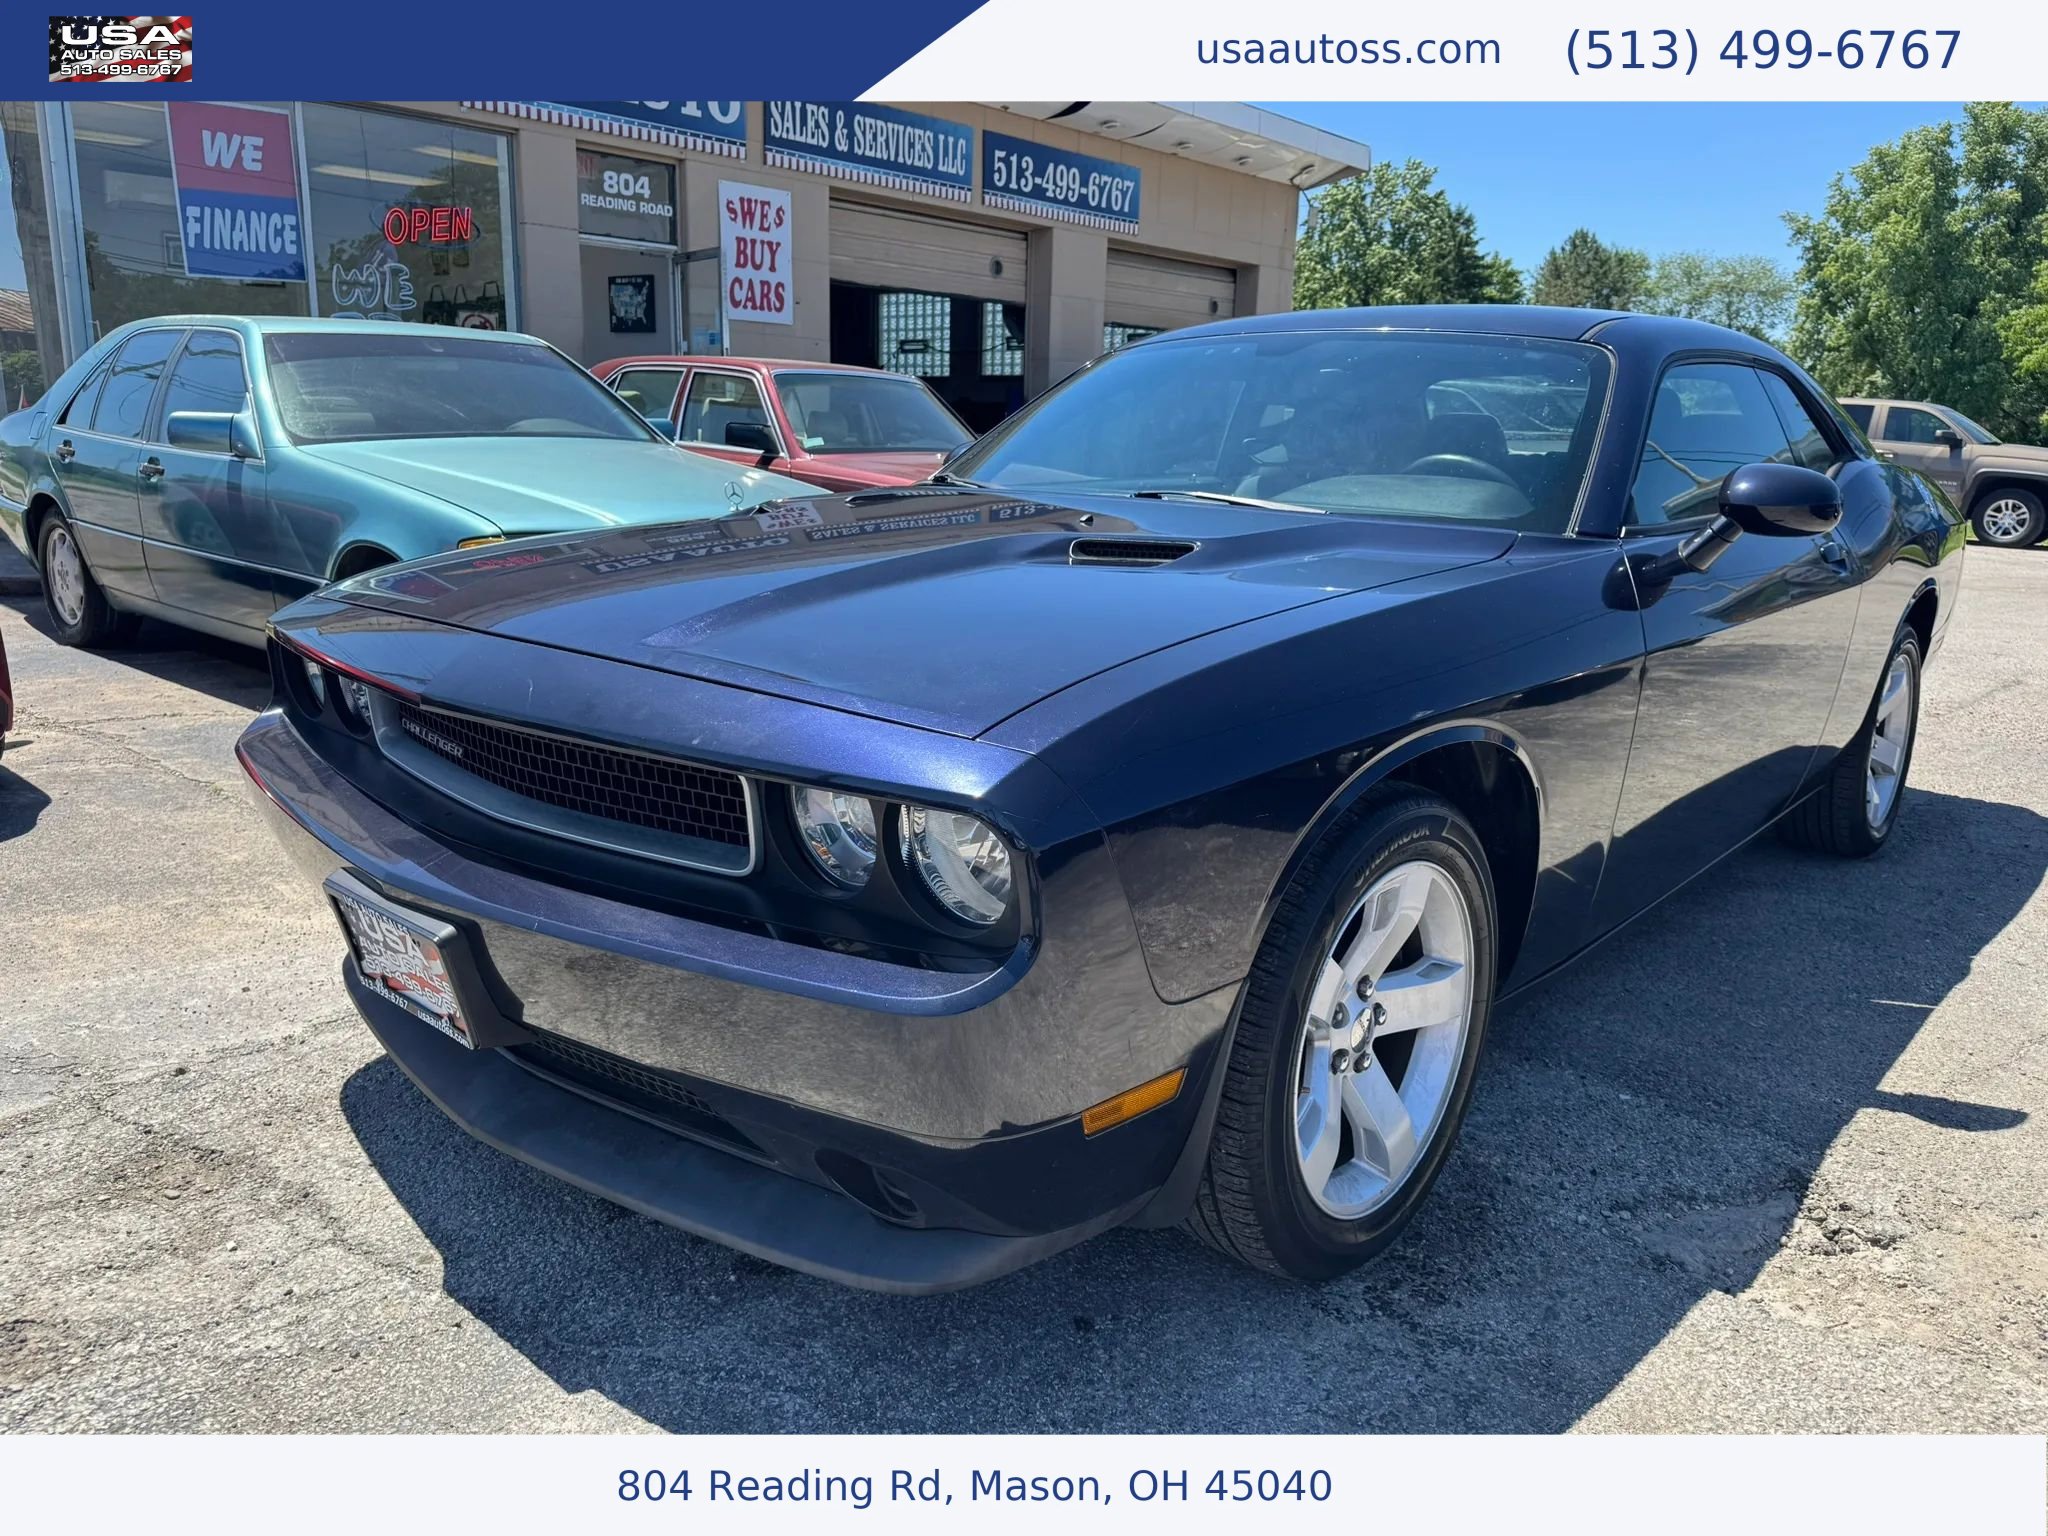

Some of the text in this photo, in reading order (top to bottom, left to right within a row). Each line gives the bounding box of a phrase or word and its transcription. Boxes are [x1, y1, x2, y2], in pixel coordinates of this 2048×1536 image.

[202, 130, 264, 171] WE
[770, 101, 829, 148] SALES
[834, 110, 849, 152] &
[854, 114, 934, 170] SERVICES
[938, 134, 966, 176] LLC
[603, 170, 651, 199] 804
[993, 149, 1135, 213] 513-499-6767
[581, 193, 673, 218] READING ROAD
[186, 206, 297, 255] FINANCE
[384, 207, 472, 245] OPEN
[735, 236, 781, 272] BUY
[332, 263, 417, 310] WE
[729, 276, 785, 313] CARS
[402, 718, 463, 758] CHALLENGER
[358, 907, 430, 967] USA
[359, 935, 453, 997] AUTO SALES
[417, 1009, 470, 1049] usaautoss.com
